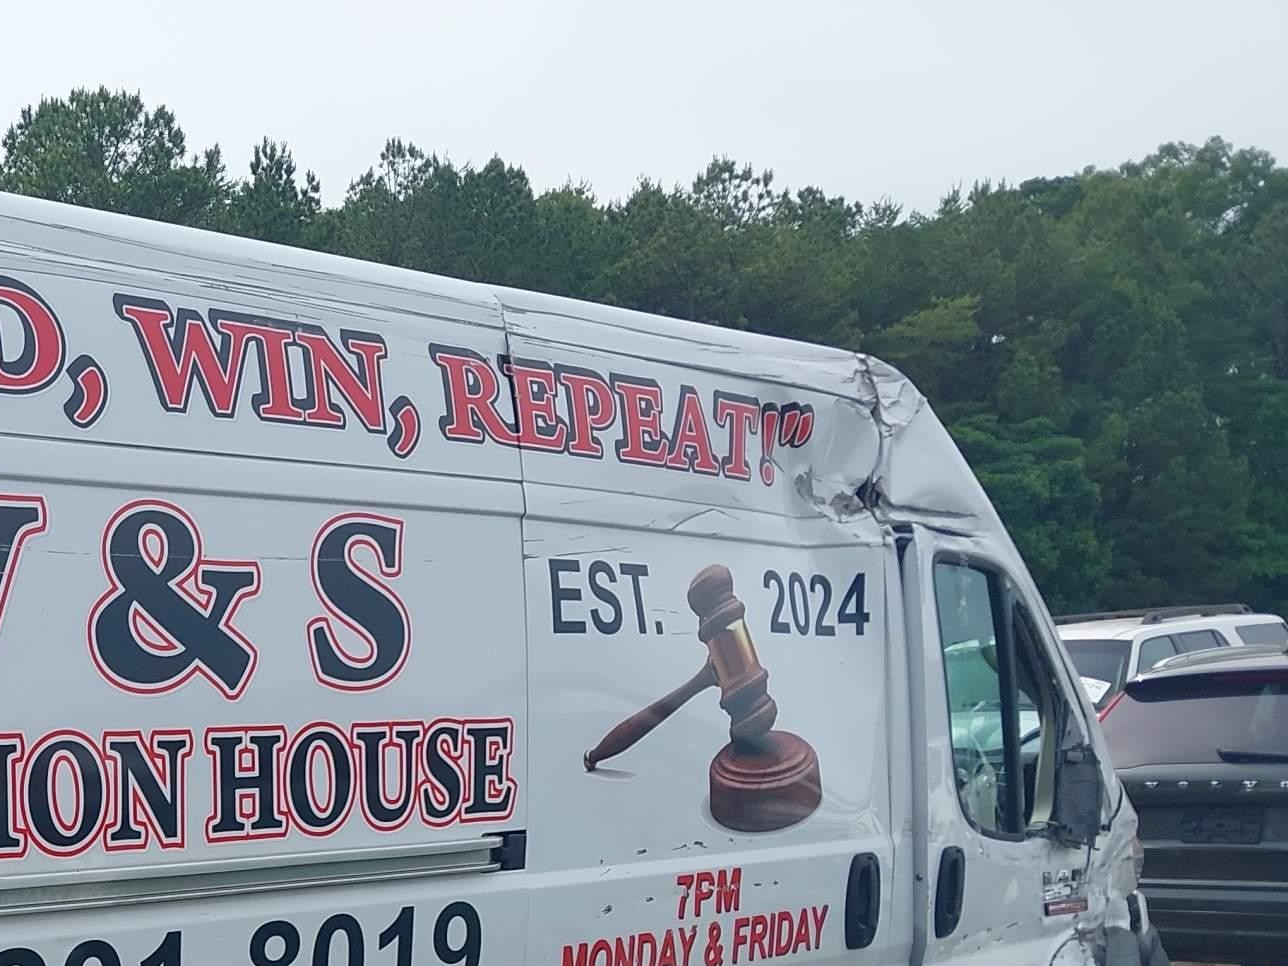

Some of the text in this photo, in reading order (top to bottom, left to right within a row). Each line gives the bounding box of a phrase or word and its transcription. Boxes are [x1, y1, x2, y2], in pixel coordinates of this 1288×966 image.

[113, 293, 421, 459] WIN,
[87, 499, 261, 701] &
[307, 512, 410, 692] S
[548, 558, 870, 636] EST. 2024
[203, 717, 517, 843] HOUSE
[676, 867, 742, 919] 7PM
[732, 904, 829, 965] FRIDAY
